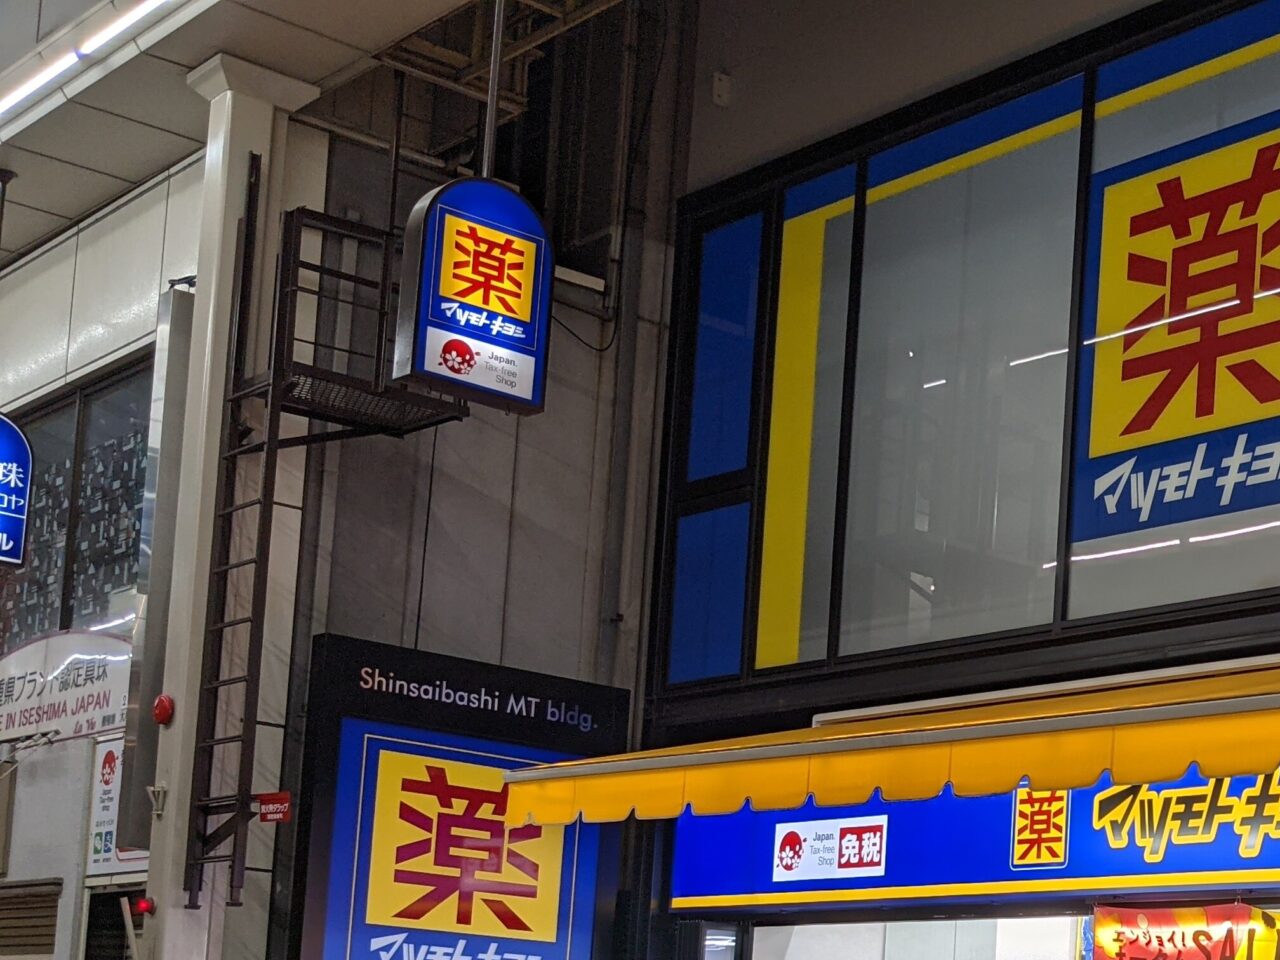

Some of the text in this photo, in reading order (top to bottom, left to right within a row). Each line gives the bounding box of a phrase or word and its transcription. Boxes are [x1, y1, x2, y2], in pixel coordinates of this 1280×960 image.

[452, 225, 525, 316] 薬
[440, 302, 527, 338] マツモトキヨシ
[484, 360, 518, 379] Tax-free
[487, 351, 518, 368] Japan.
[495, 374, 517, 389] Shop
[5, 711, 17, 730] IN
[19, 699, 68, 728] ISESHIMA
[71, 689, 111, 716] JAPAN
[359, 666, 598, 732] Shinsaibashi MT bldg.
[812, 831, 836, 843] Japan.
[1015, 790, 1064, 861] 薬
[392, 765, 543, 932] 薬
[809, 844, 836, 855] Tax-free
[817, 855, 835, 867] Shop
[839, 829, 882, 865] 免税
